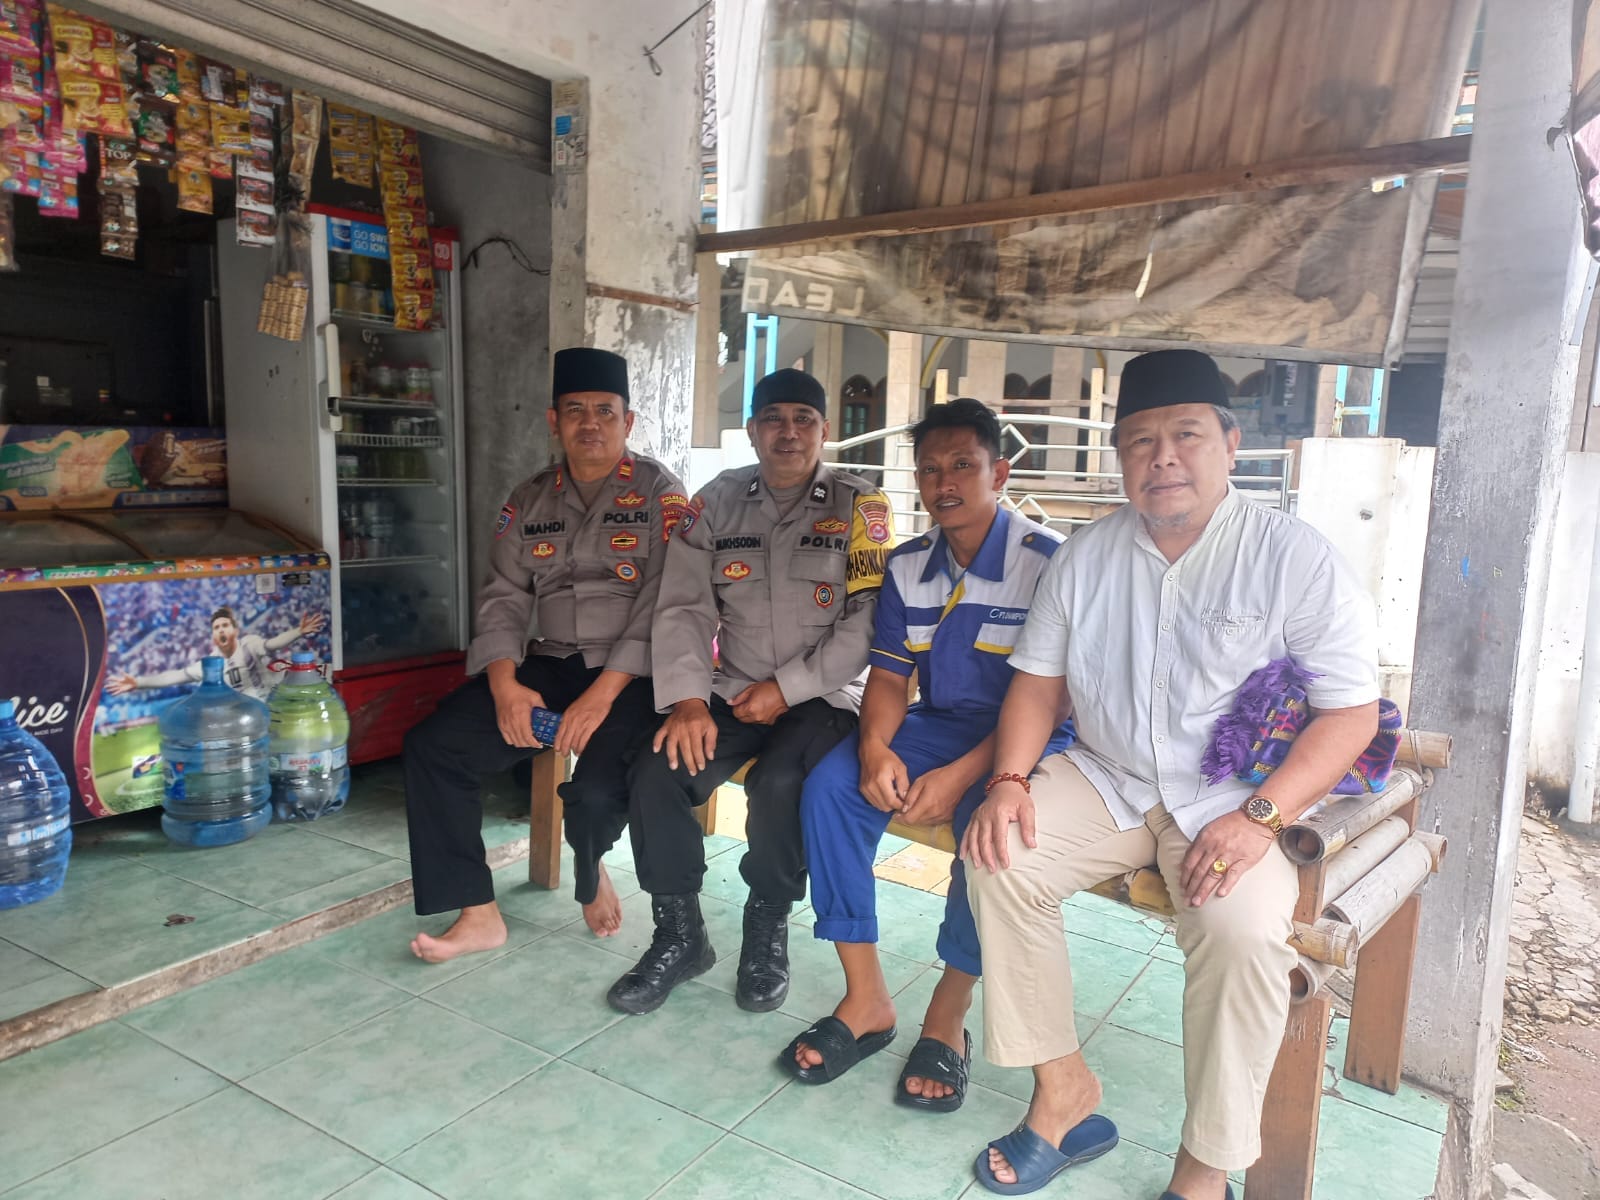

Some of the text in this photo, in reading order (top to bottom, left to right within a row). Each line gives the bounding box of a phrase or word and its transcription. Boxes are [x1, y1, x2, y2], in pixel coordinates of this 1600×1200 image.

[106, 147, 132, 160] TOP
[603, 511, 649, 524] POLRI
[524, 521, 566, 536] MAHDI
[800, 535, 849, 552] POLRI
